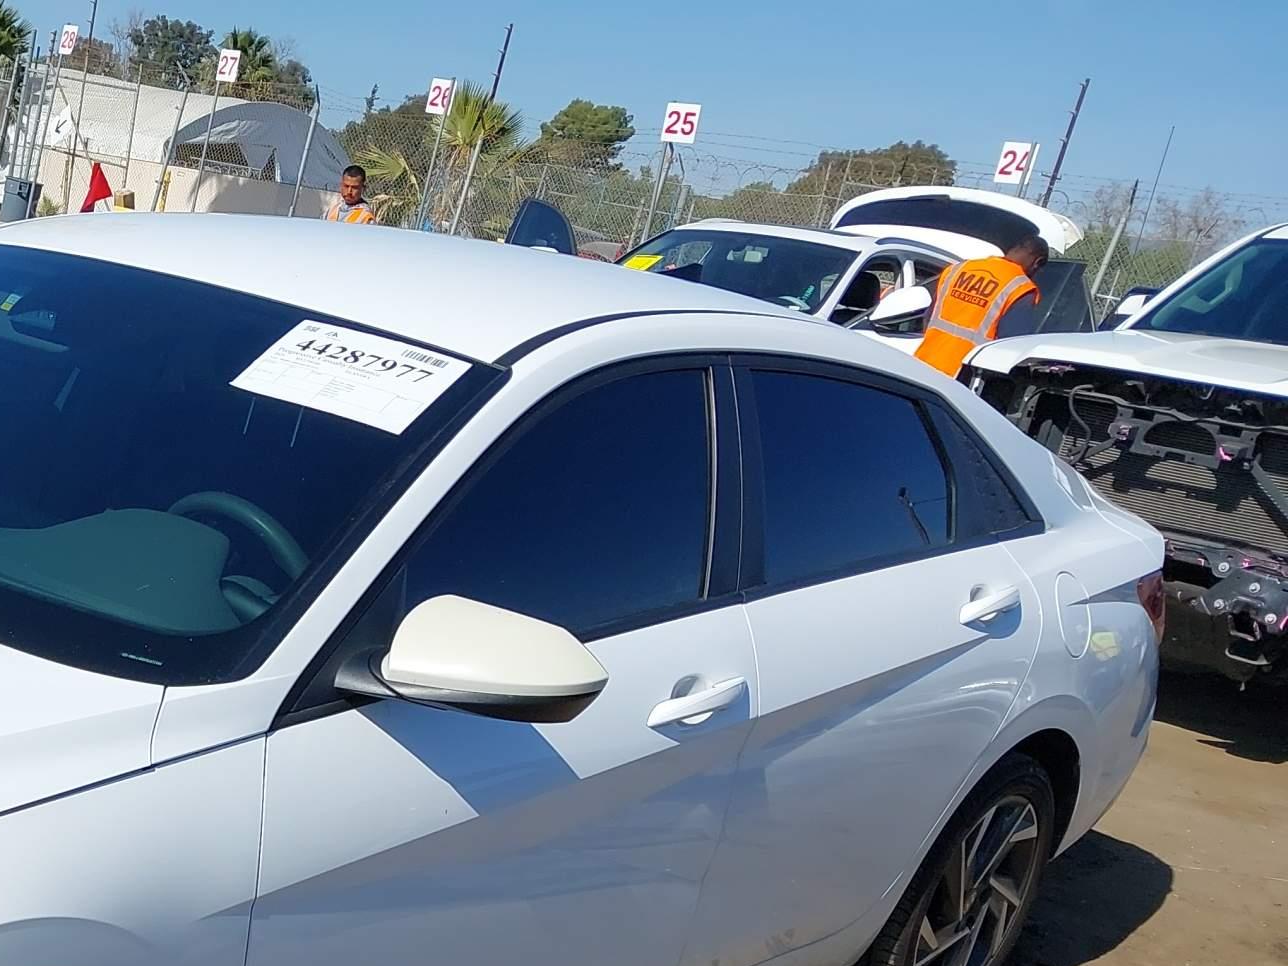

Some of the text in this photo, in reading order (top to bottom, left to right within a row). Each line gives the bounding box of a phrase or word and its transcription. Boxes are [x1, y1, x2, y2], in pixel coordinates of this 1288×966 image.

[61, 31, 76, 49] 28
[218, 55, 238, 76] 27
[665, 111, 696, 135] 25
[953, 271, 999, 298] MAD
[295, 339, 435, 383] 44287977
